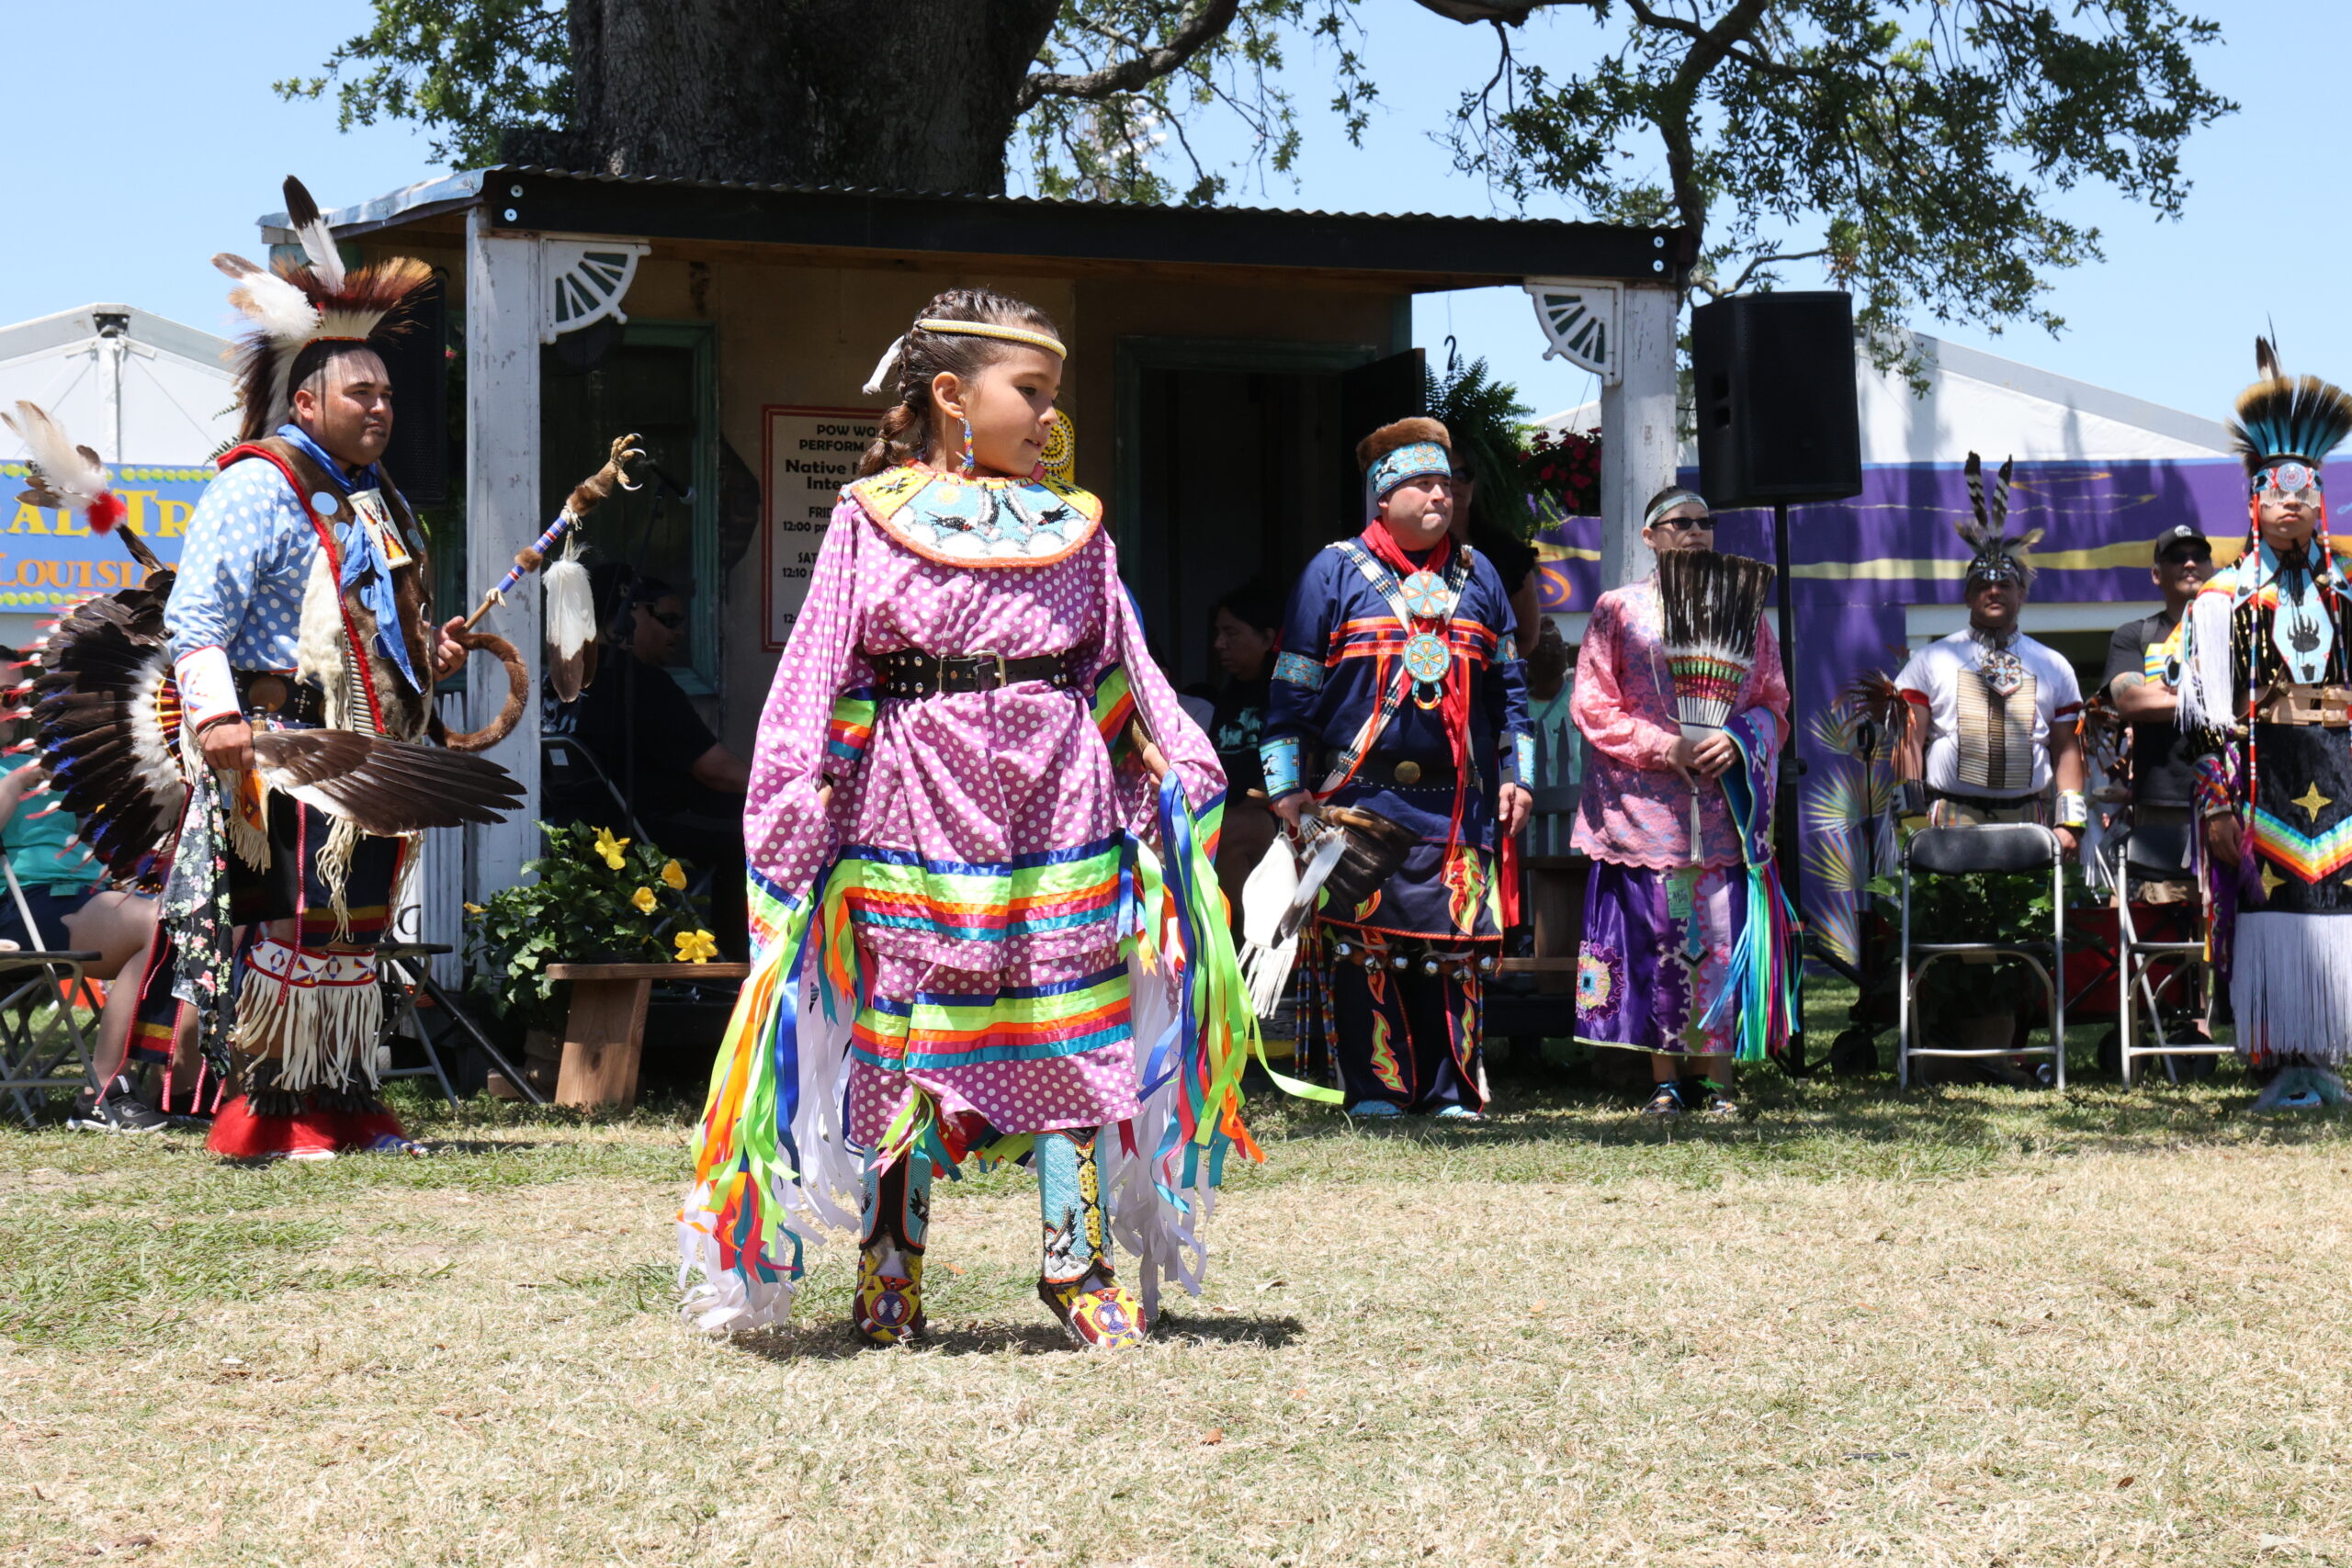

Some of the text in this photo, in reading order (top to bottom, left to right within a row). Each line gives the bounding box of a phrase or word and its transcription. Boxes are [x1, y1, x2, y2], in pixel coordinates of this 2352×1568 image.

[817, 424, 877, 437] POW WO
[786, 459, 846, 474] Native
[807, 476, 852, 490] Inte
[0, 497, 91, 537] AL
[783, 521, 810, 532] 12:00
[782, 568, 807, 578] 12:10
